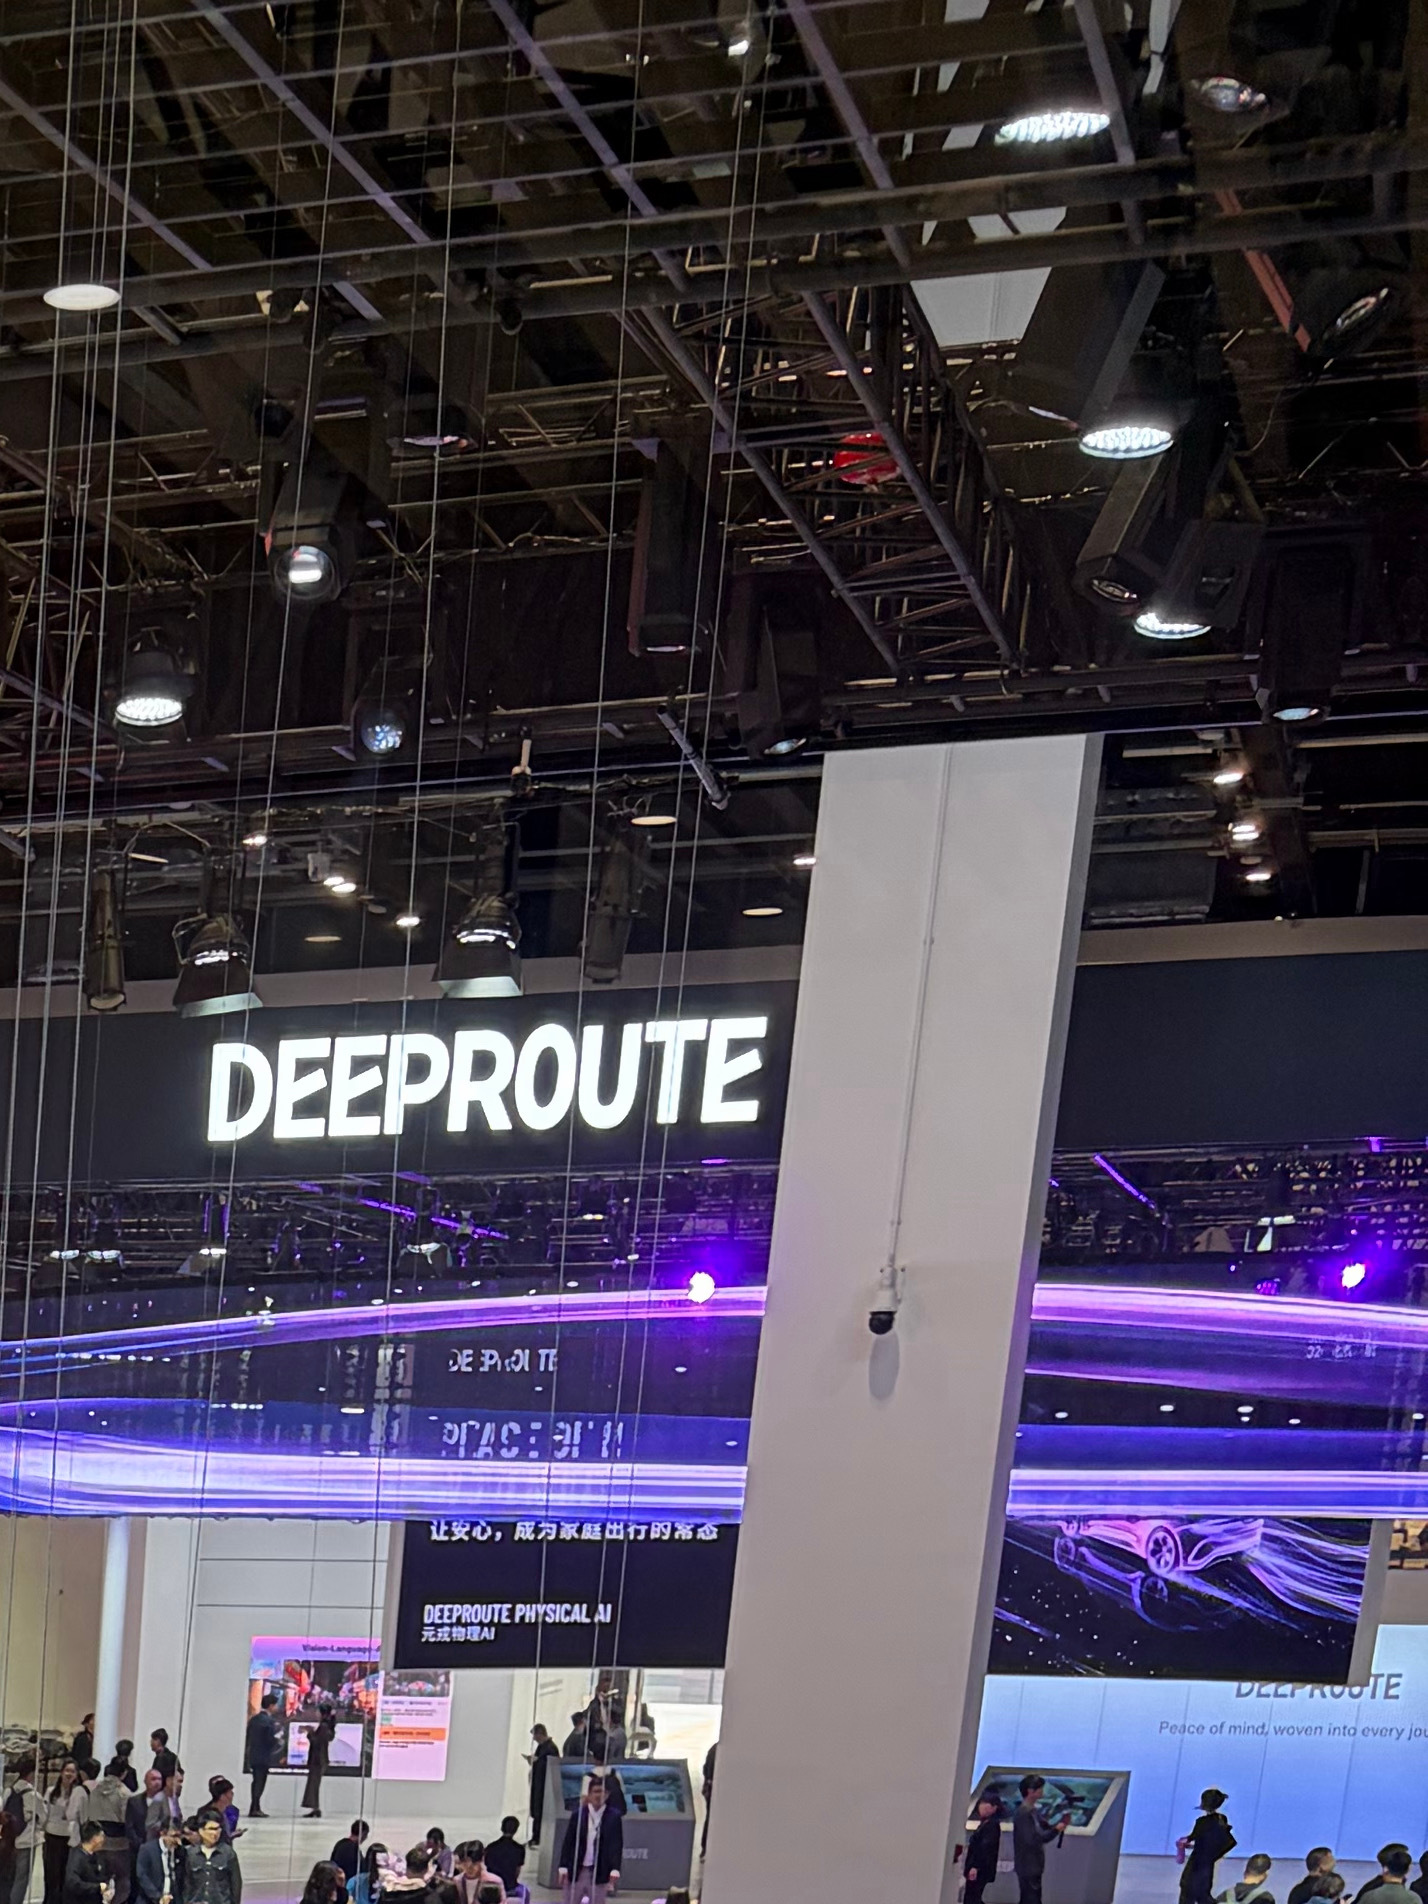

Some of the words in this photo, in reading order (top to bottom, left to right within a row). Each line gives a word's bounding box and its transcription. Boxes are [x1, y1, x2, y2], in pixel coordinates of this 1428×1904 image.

[207, 1016, 768, 1142] DEEPROUTE
[424, 1603, 512, 1624] DEEPROUTE
[514, 1603, 591, 1624] PHYSICAL
[594, 1603, 612, 1624] AI
[421, 1626, 496, 1642] 元戎物理AI
[1159, 1720, 1204, 1735] Peace
[1209, 1720, 1227, 1735] of
[1228, 1721, 1269, 1738] mind,
[1273, 1724, 1323, 1736] woven
[1328, 1723, 1357, 1737] into
[1362, 1725, 1404, 1740] every
